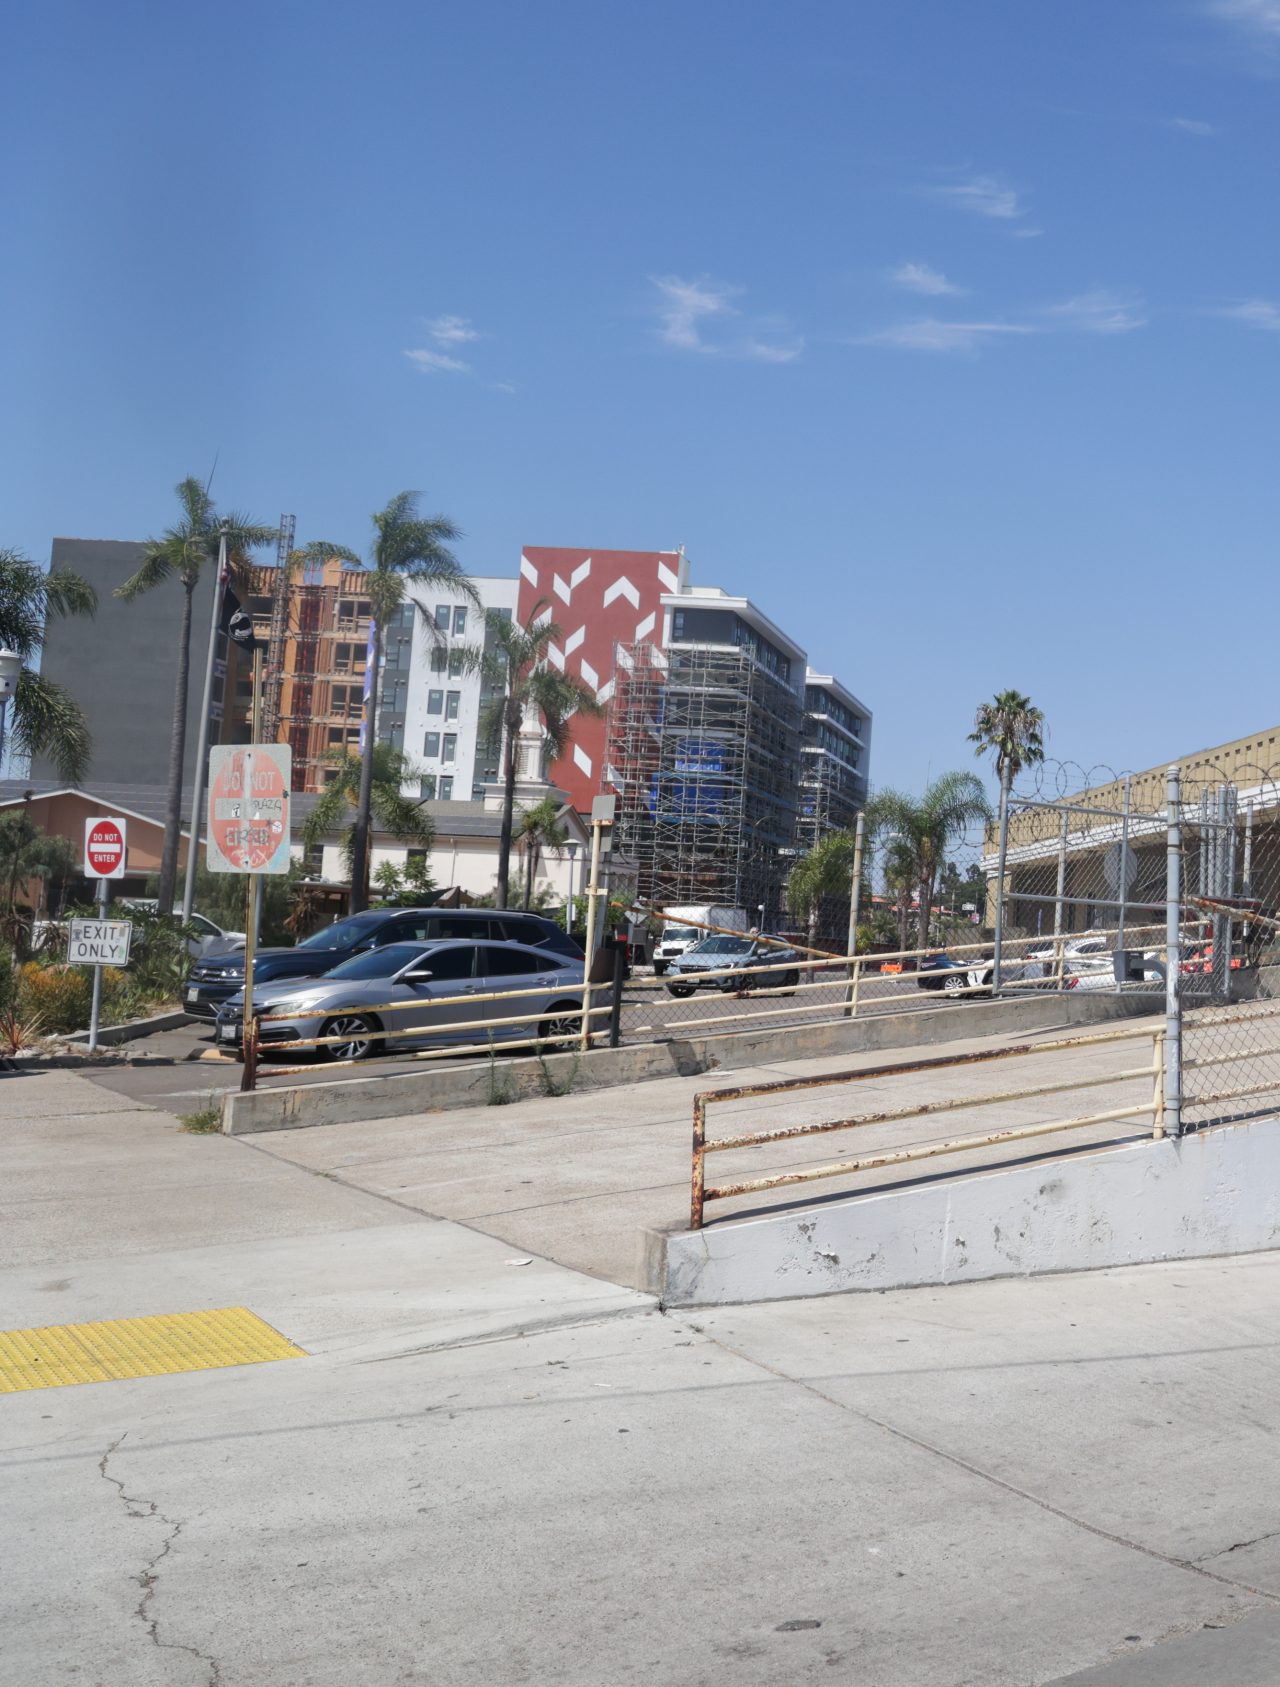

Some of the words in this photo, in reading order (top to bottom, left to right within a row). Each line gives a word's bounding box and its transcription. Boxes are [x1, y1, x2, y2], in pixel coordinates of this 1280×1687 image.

[93, 833, 103, 841] DO
[104, 833, 118, 841] NOT
[225, 827, 269, 846] EER
[94, 854, 116, 863] ENTER
[83, 925, 118, 940] EXIT
[77, 943, 119, 958] ONLY
